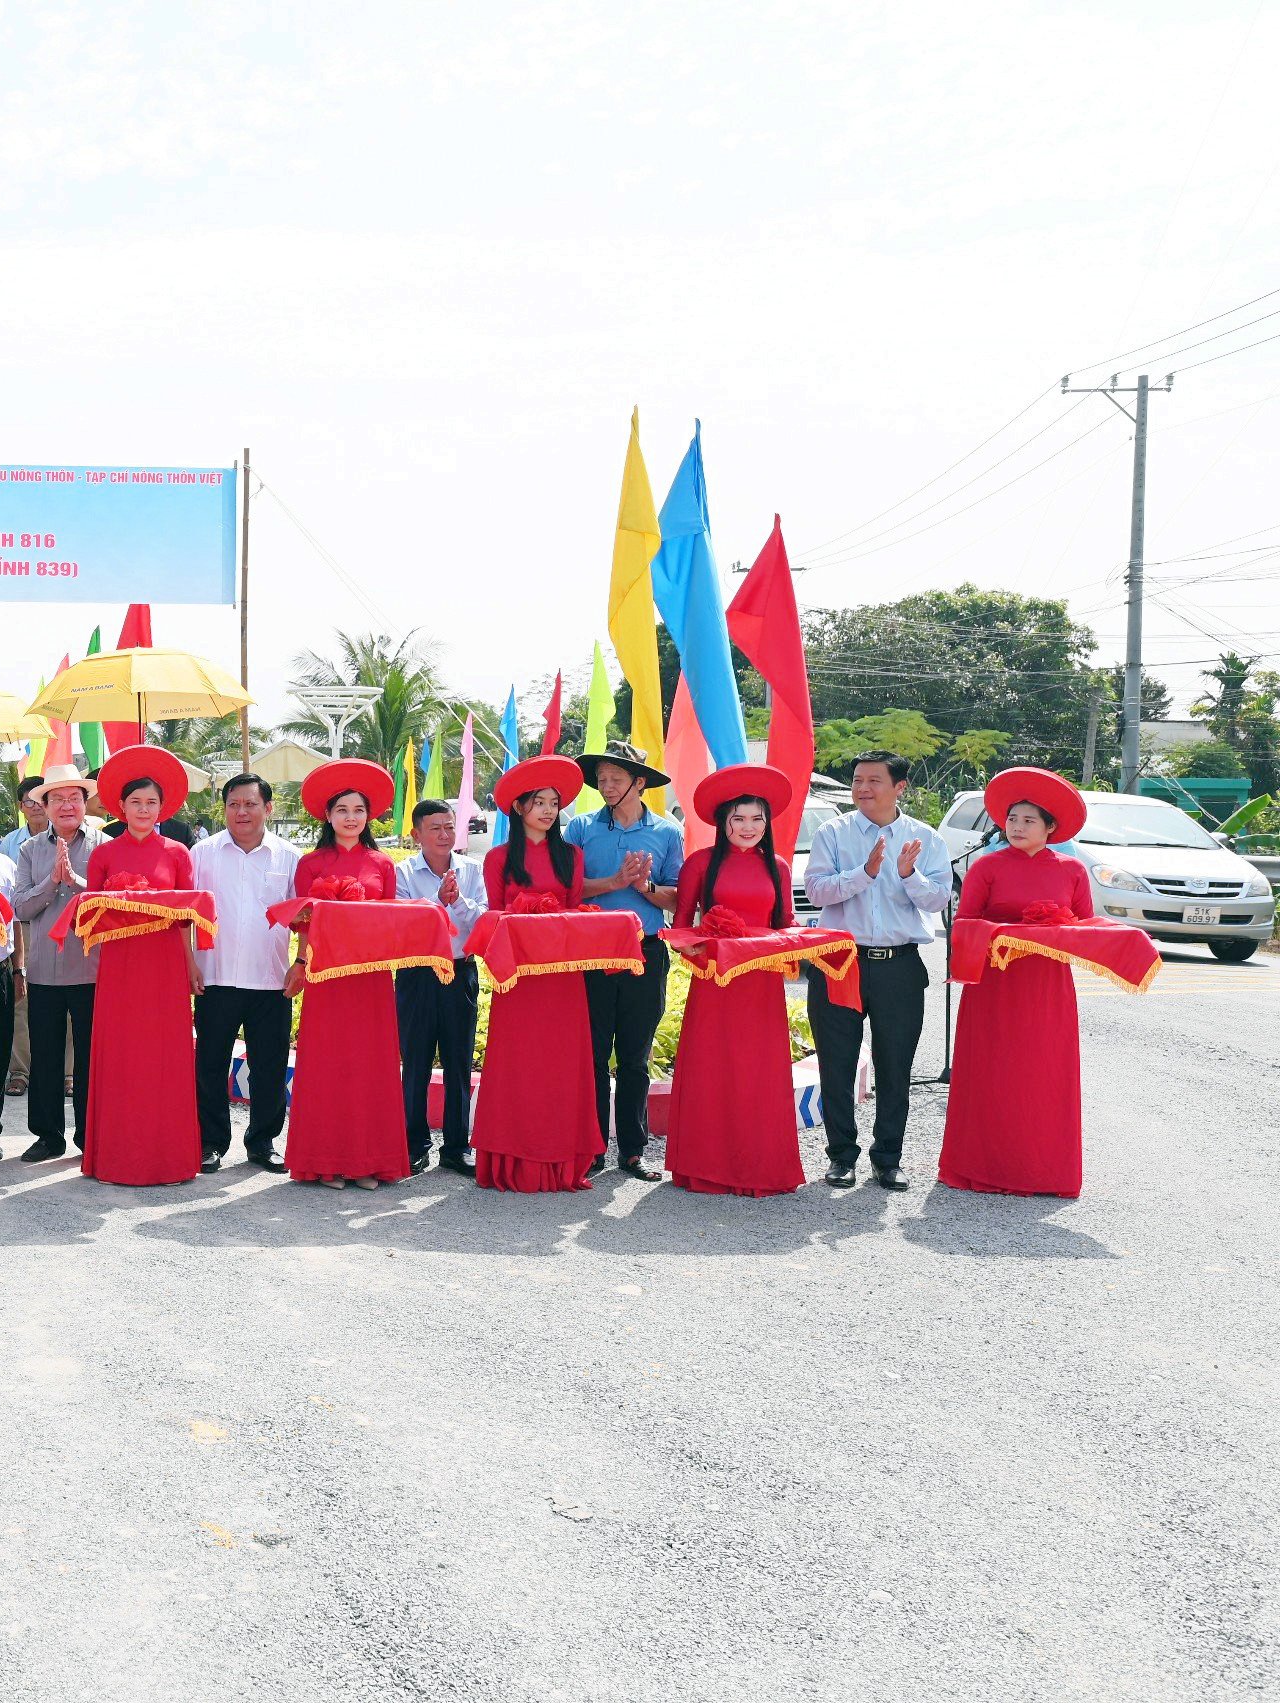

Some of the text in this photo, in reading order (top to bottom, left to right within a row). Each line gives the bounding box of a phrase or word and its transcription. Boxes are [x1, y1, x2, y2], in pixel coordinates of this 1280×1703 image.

[10, 467, 42, 482] NÔNG
[45, 468, 75, 483] THÔN
[85, 470, 106, 485] TẠP
[109, 469, 129, 483] CHÍ
[131, 470, 163, 484] NÔNG
[166, 470, 196, 484] THÔN
[199, 471, 223, 486] VIỆT
[20, 533, 56, 549] 816
[36, 561, 78, 578] 839)
[1186, 915, 1216, 923] 609.97
[1194, 907, 1211, 916] 51K
